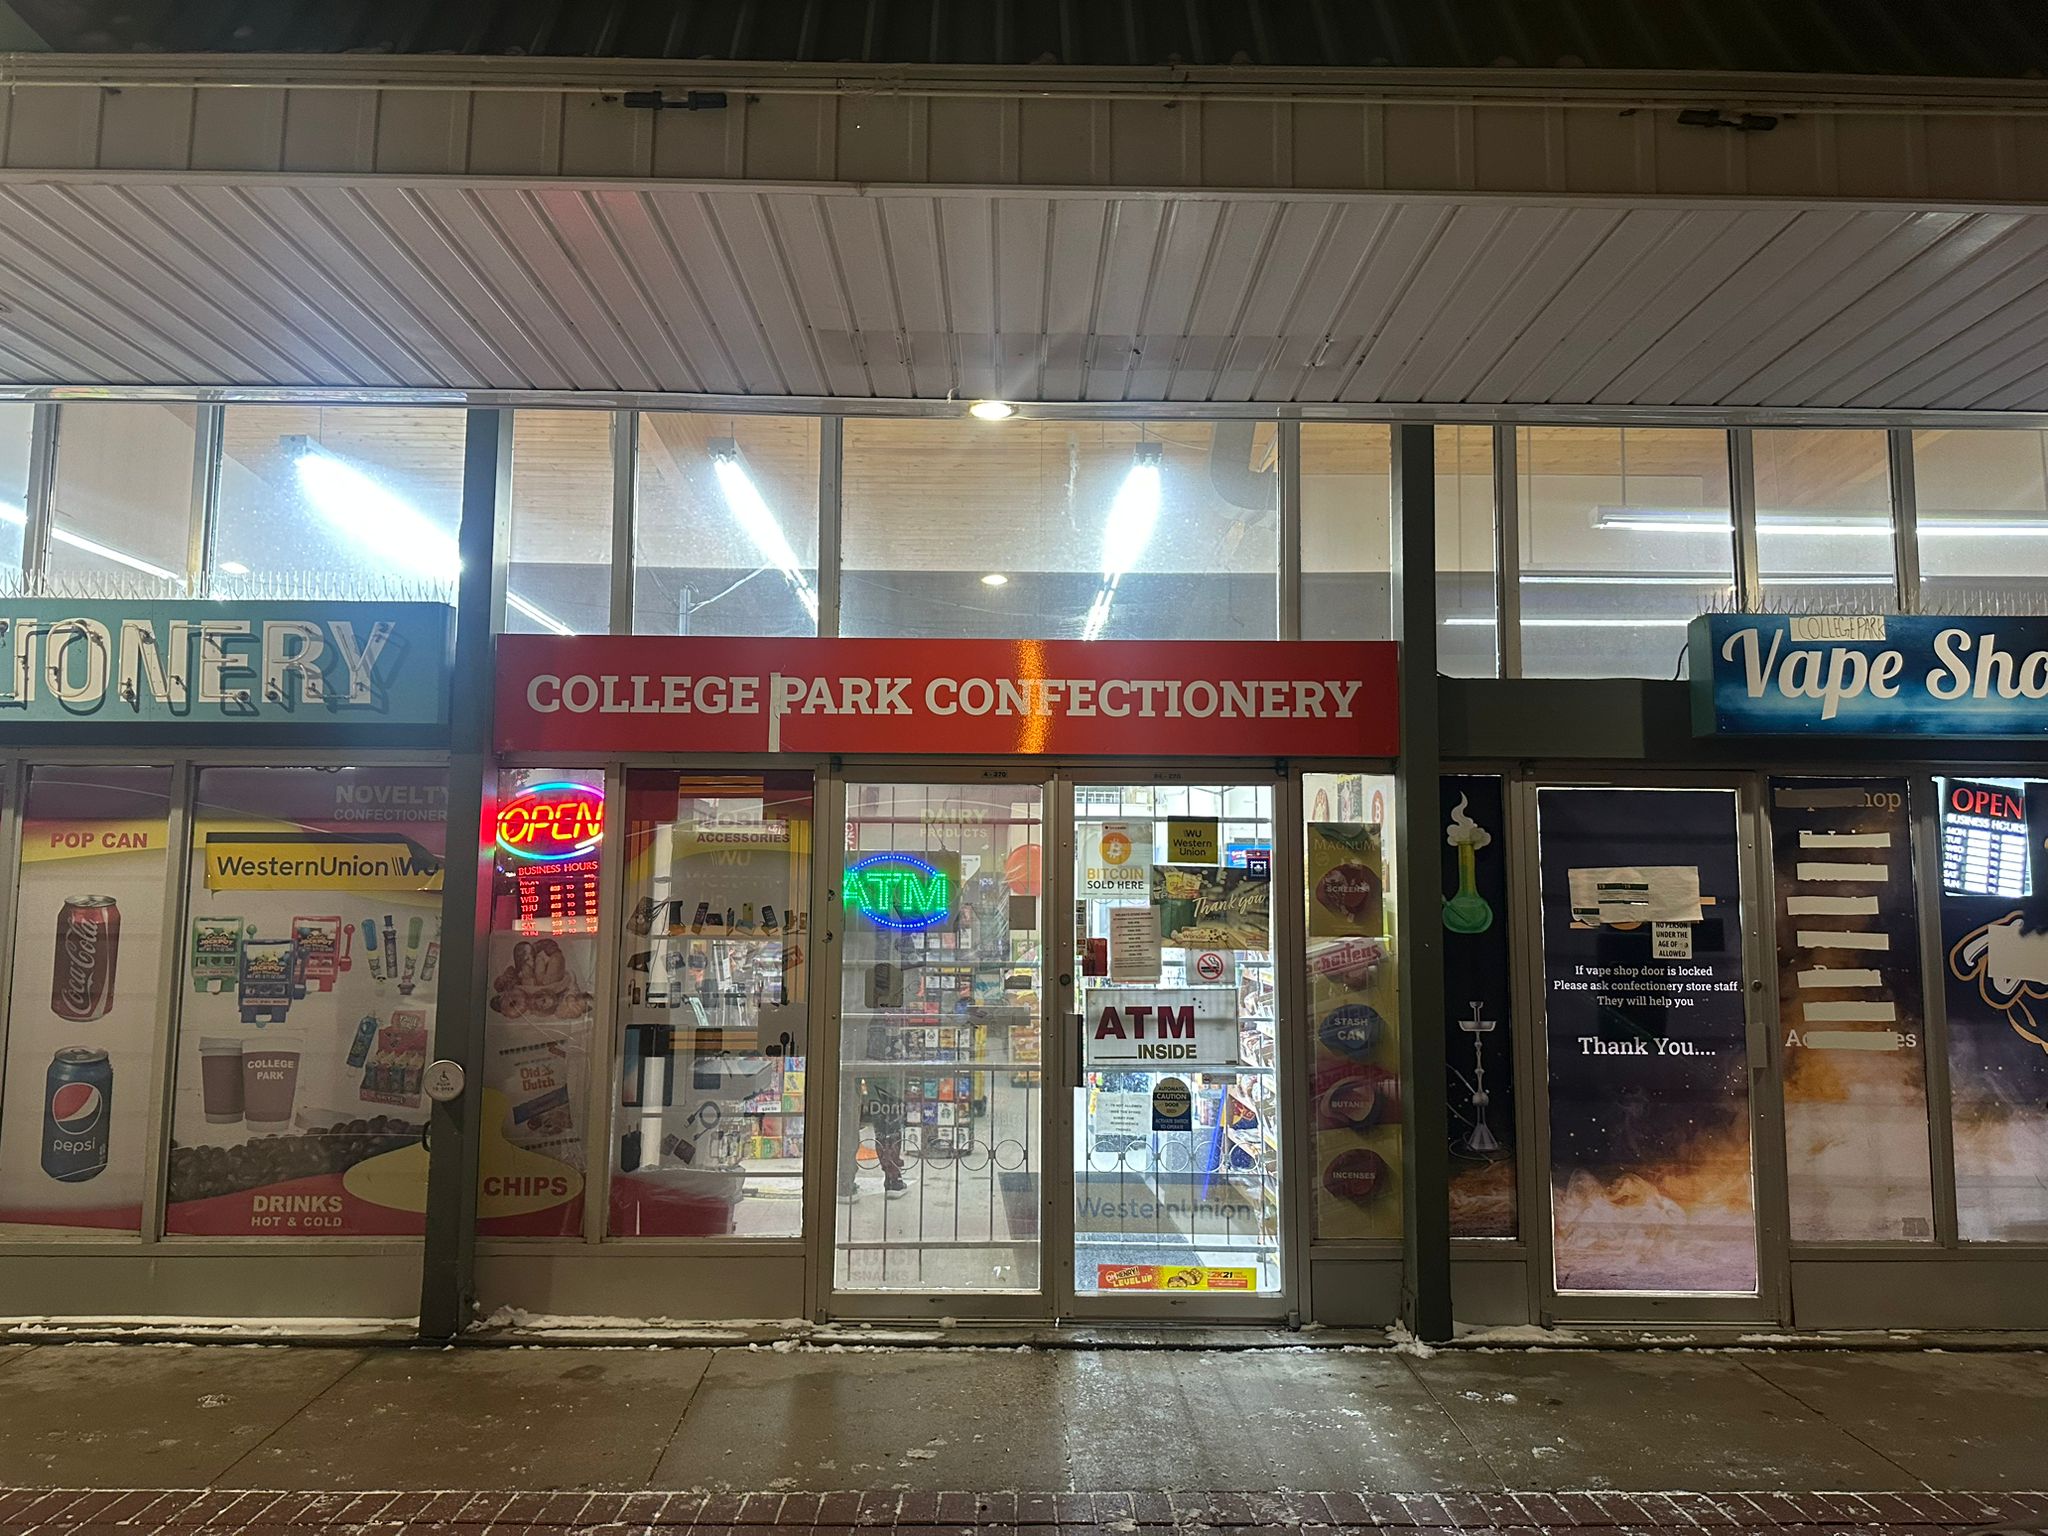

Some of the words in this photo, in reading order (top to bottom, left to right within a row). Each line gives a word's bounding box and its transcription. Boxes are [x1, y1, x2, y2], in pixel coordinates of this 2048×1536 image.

[1798, 618, 1856, 641] COLLEGE
[1857, 616, 1886, 641] PARK
[0, 617, 397, 704] IONERY
[1721, 628, 1904, 721] Vape
[526, 674, 760, 715] COLLEGE
[779, 676, 913, 716] PARK
[924, 676, 1363, 719] CONFECTIONERY
[1952, 787, 2024, 820] OPEN
[500, 801, 604, 843] OPEN
[919, 807, 989, 825] DAIRY
[1946, 813, 1990, 828] BUSINESS
[1991, 819, 2026, 834] HOURS
[696, 832, 790, 843] ACCESSORIES
[919, 827, 988, 838] PRODUCTS
[50, 832, 94, 849] POP
[102, 832, 148, 849] CAN
[1173, 839, 1212, 847] Western
[1313, 839, 1376, 851] MAGNUM
[1179, 847, 1206, 856] Union
[217, 854, 389, 877] WesternUnion
[518, 864, 561, 876] BUSINESS
[563, 861, 598, 872] HOURS
[1087, 867, 1144, 880] BITCOIN
[520, 887, 536, 895] TUE
[843, 872, 947, 911] ATM
[1087, 880, 1115, 889] SOLD
[1117, 880, 1144, 890] HERE
[520, 895, 539, 904] WED
[1192, 893, 1237, 918] Thank
[1238, 894, 1266, 914] you
[521, 904, 538, 912] THU
[521, 913, 533, 921] FRI
[521, 922, 536, 930] SAT
[1575, 965, 1584, 976] If
[1586, 967, 1612, 977] vape
[1613, 965, 1639, 977] shop
[1641, 966, 1664, 976] door
[1667, 966, 1677, 976] is
[1678, 966, 1713, 976] locked
[1553, 980, 1588, 990] Please
[1590, 981, 1609, 990] ask
[1611, 981, 1684, 993] confectionery
[1685, 982, 1712, 991] store
[1713, 981, 1738, 991] staff
[1596, 996, 1624, 1007] They
[1626, 996, 1647, 1006] will
[1649, 996, 1672, 1007] help
[1673, 998, 1694, 1008] you
[1095, 1005, 1196, 1040] ATM
[1334, 1017, 1368, 1026] STASH
[1337, 1030, 1366, 1041] CAN
[1137, 1043, 1197, 1060] INSIDE
[1578, 1036, 1649, 1056] Thank
[1653, 1037, 1716, 1056] You....
[247, 1058, 295, 1070] COLLEGE
[256, 1070, 284, 1081] PARK
[520, 1066, 541, 1080] Old
[522, 1077, 556, 1092] Dutch
[53, 1136, 96, 1154] pepsi
[1332, 1171, 1376, 1179] INCENSES
[483, 1176, 569, 1197] CHIPS
[252, 1195, 343, 1214] DRINKS
[1077, 1196, 1250, 1220] WesternUnion
[251, 1215, 281, 1227] HOT
[287, 1216, 298, 1227] &
[303, 1216, 343, 1228] COLD
[1113, 1277, 1141, 1287] LEVEL
[1141, 1274, 1153, 1283] UP
[1211, 1271, 1233, 1279] 2K21
